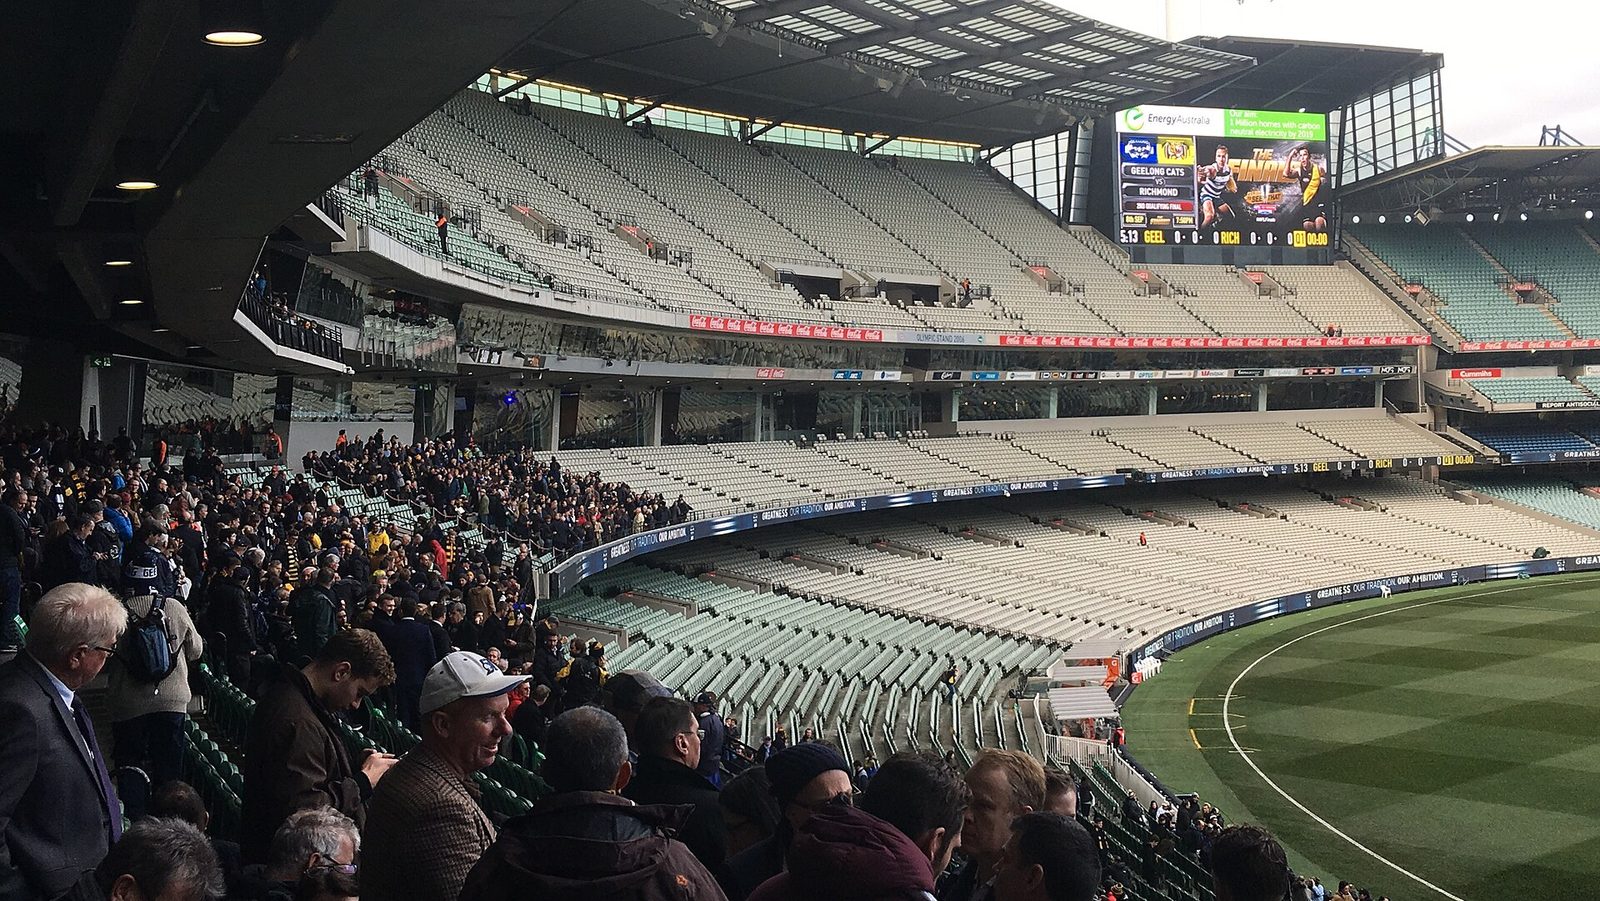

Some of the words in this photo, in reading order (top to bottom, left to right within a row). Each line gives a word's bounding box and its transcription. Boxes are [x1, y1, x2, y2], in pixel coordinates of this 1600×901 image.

[1148, 113, 1210, 126] EnergyAustralia
[1259, 120, 1280, 129] homes
[1282, 121, 1297, 129] with
[1298, 121, 1321, 130] carbon
[1253, 148, 1274, 159] THE
[1131, 166, 1165, 175] GEELONG
[1166, 168, 1185, 176] CATS
[1228, 159, 1299, 183] FINAL
[1139, 188, 1178, 197] RICHMOND
[1120, 229, 1139, 243] 5:13
[1144, 230, 1165, 243] GEEL
[1220, 231, 1240, 244] RICH
[1294, 463, 1308, 473] 5:13
[1312, 462, 1330, 472] GEEL
[1375, 459, 1393, 468] RICH
[1161, 470, 1193, 479] GREATNESS
[943, 487, 973, 497] GREATNESS
[1010, 482, 1021, 490] OUR
[761, 508, 788, 521] GREATNESS
[824, 503, 834, 511] OUR
[1317, 586, 1351, 599] GREATNESS
[1352, 582, 1366, 593] OUR
[1397, 576, 1411, 585] OUR
[1194, 621, 1203, 633] OUR
